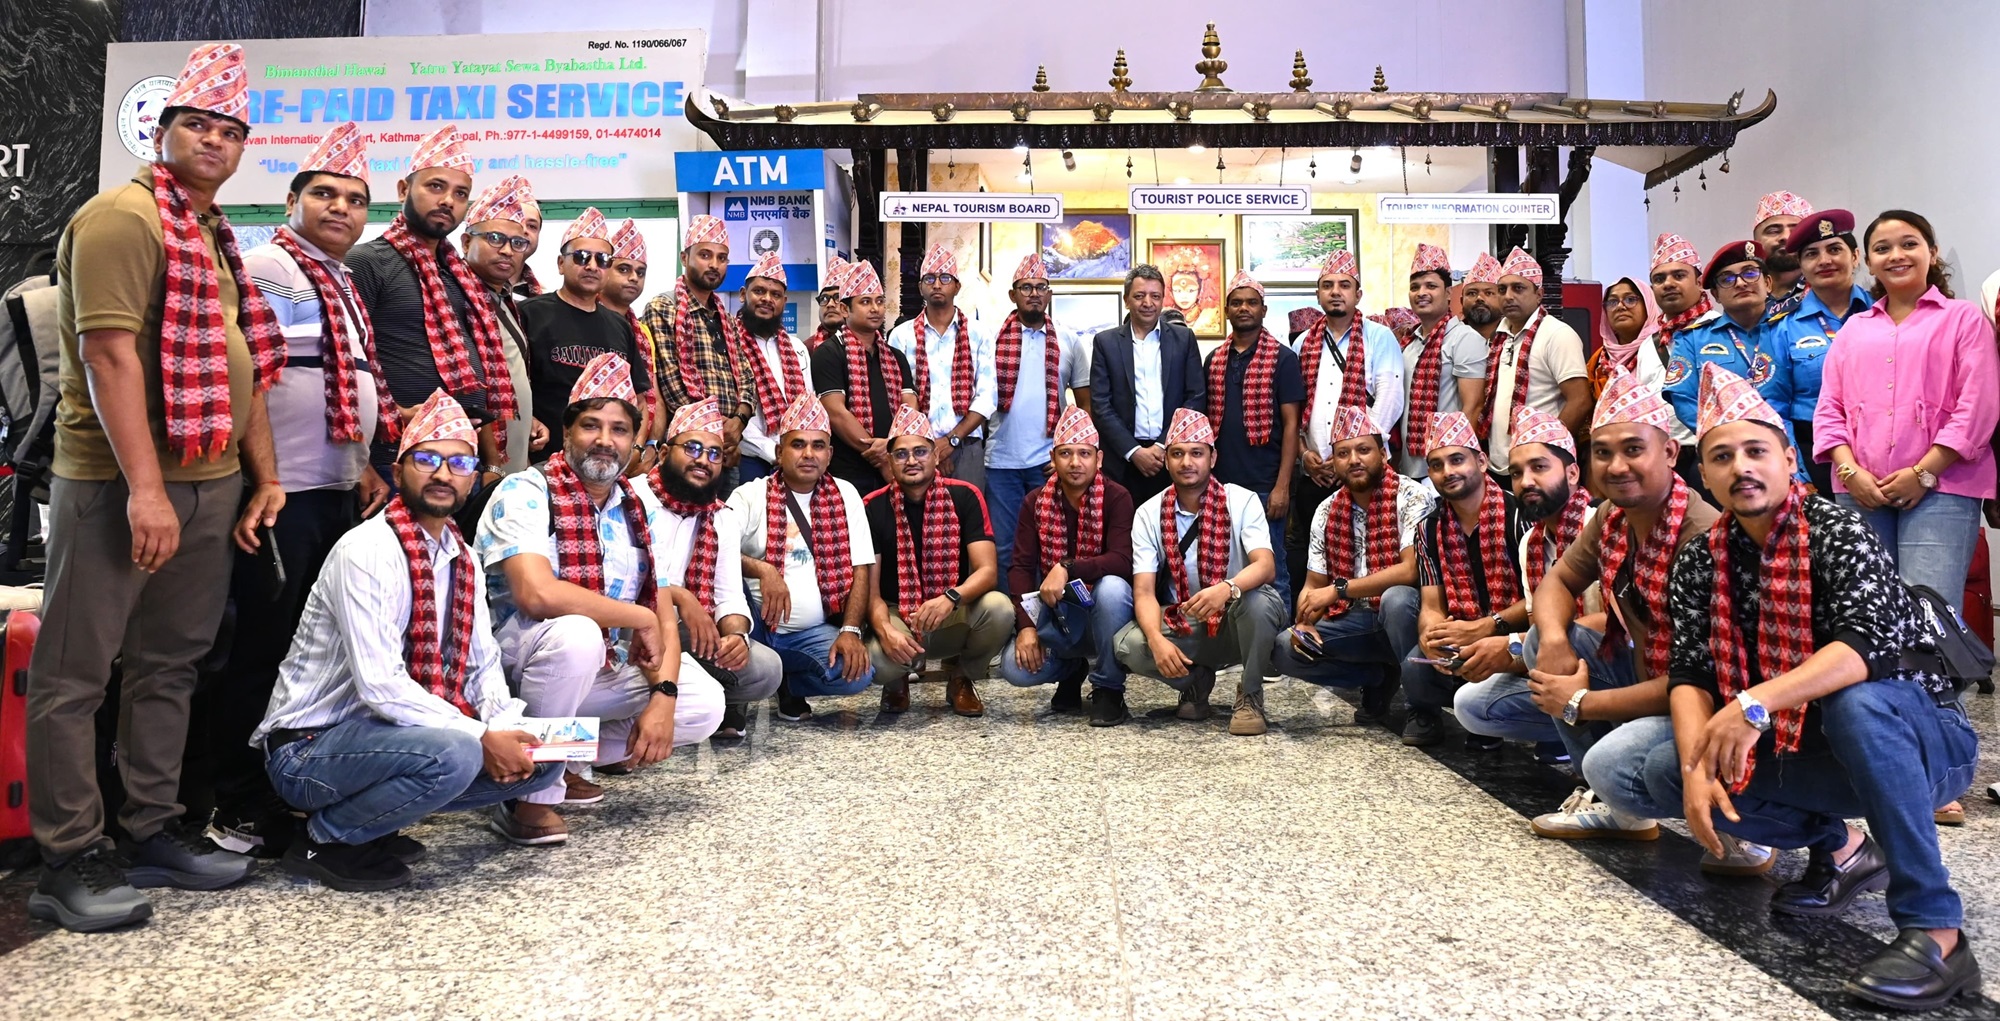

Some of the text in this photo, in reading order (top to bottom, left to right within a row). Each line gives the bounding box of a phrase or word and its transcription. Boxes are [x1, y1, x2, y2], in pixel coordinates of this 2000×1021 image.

[588, 39, 687, 50] Regd. No. 1190/066/067
[344, 63, 386, 77] Hawai
[452, 61, 501, 75] Yatayat
[505, 60, 540, 72] Sewa
[544, 58, 615, 73] Byabastha
[619, 57, 647, 70] Ltd.
[247, 81, 684, 124] RE-PAID TAXI SERVICE
[270, 135, 322, 145] Internatio
[380, 132, 421, 142] Kathma
[462, 131, 481, 142] pal,
[596, 128, 661, 139] 01-4474014
[369, 157, 399, 171] taxi
[488, 155, 519, 169] and
[713, 155, 787, 185] ATM
[750, 195, 811, 206] NMB BANK
[1140, 194, 1299, 205] TOURIST POLICE SERVICE
[912, 203, 1051, 213] NEPAL TOURISM BOARD
[1502, 204, 1550, 213] COUNTER
